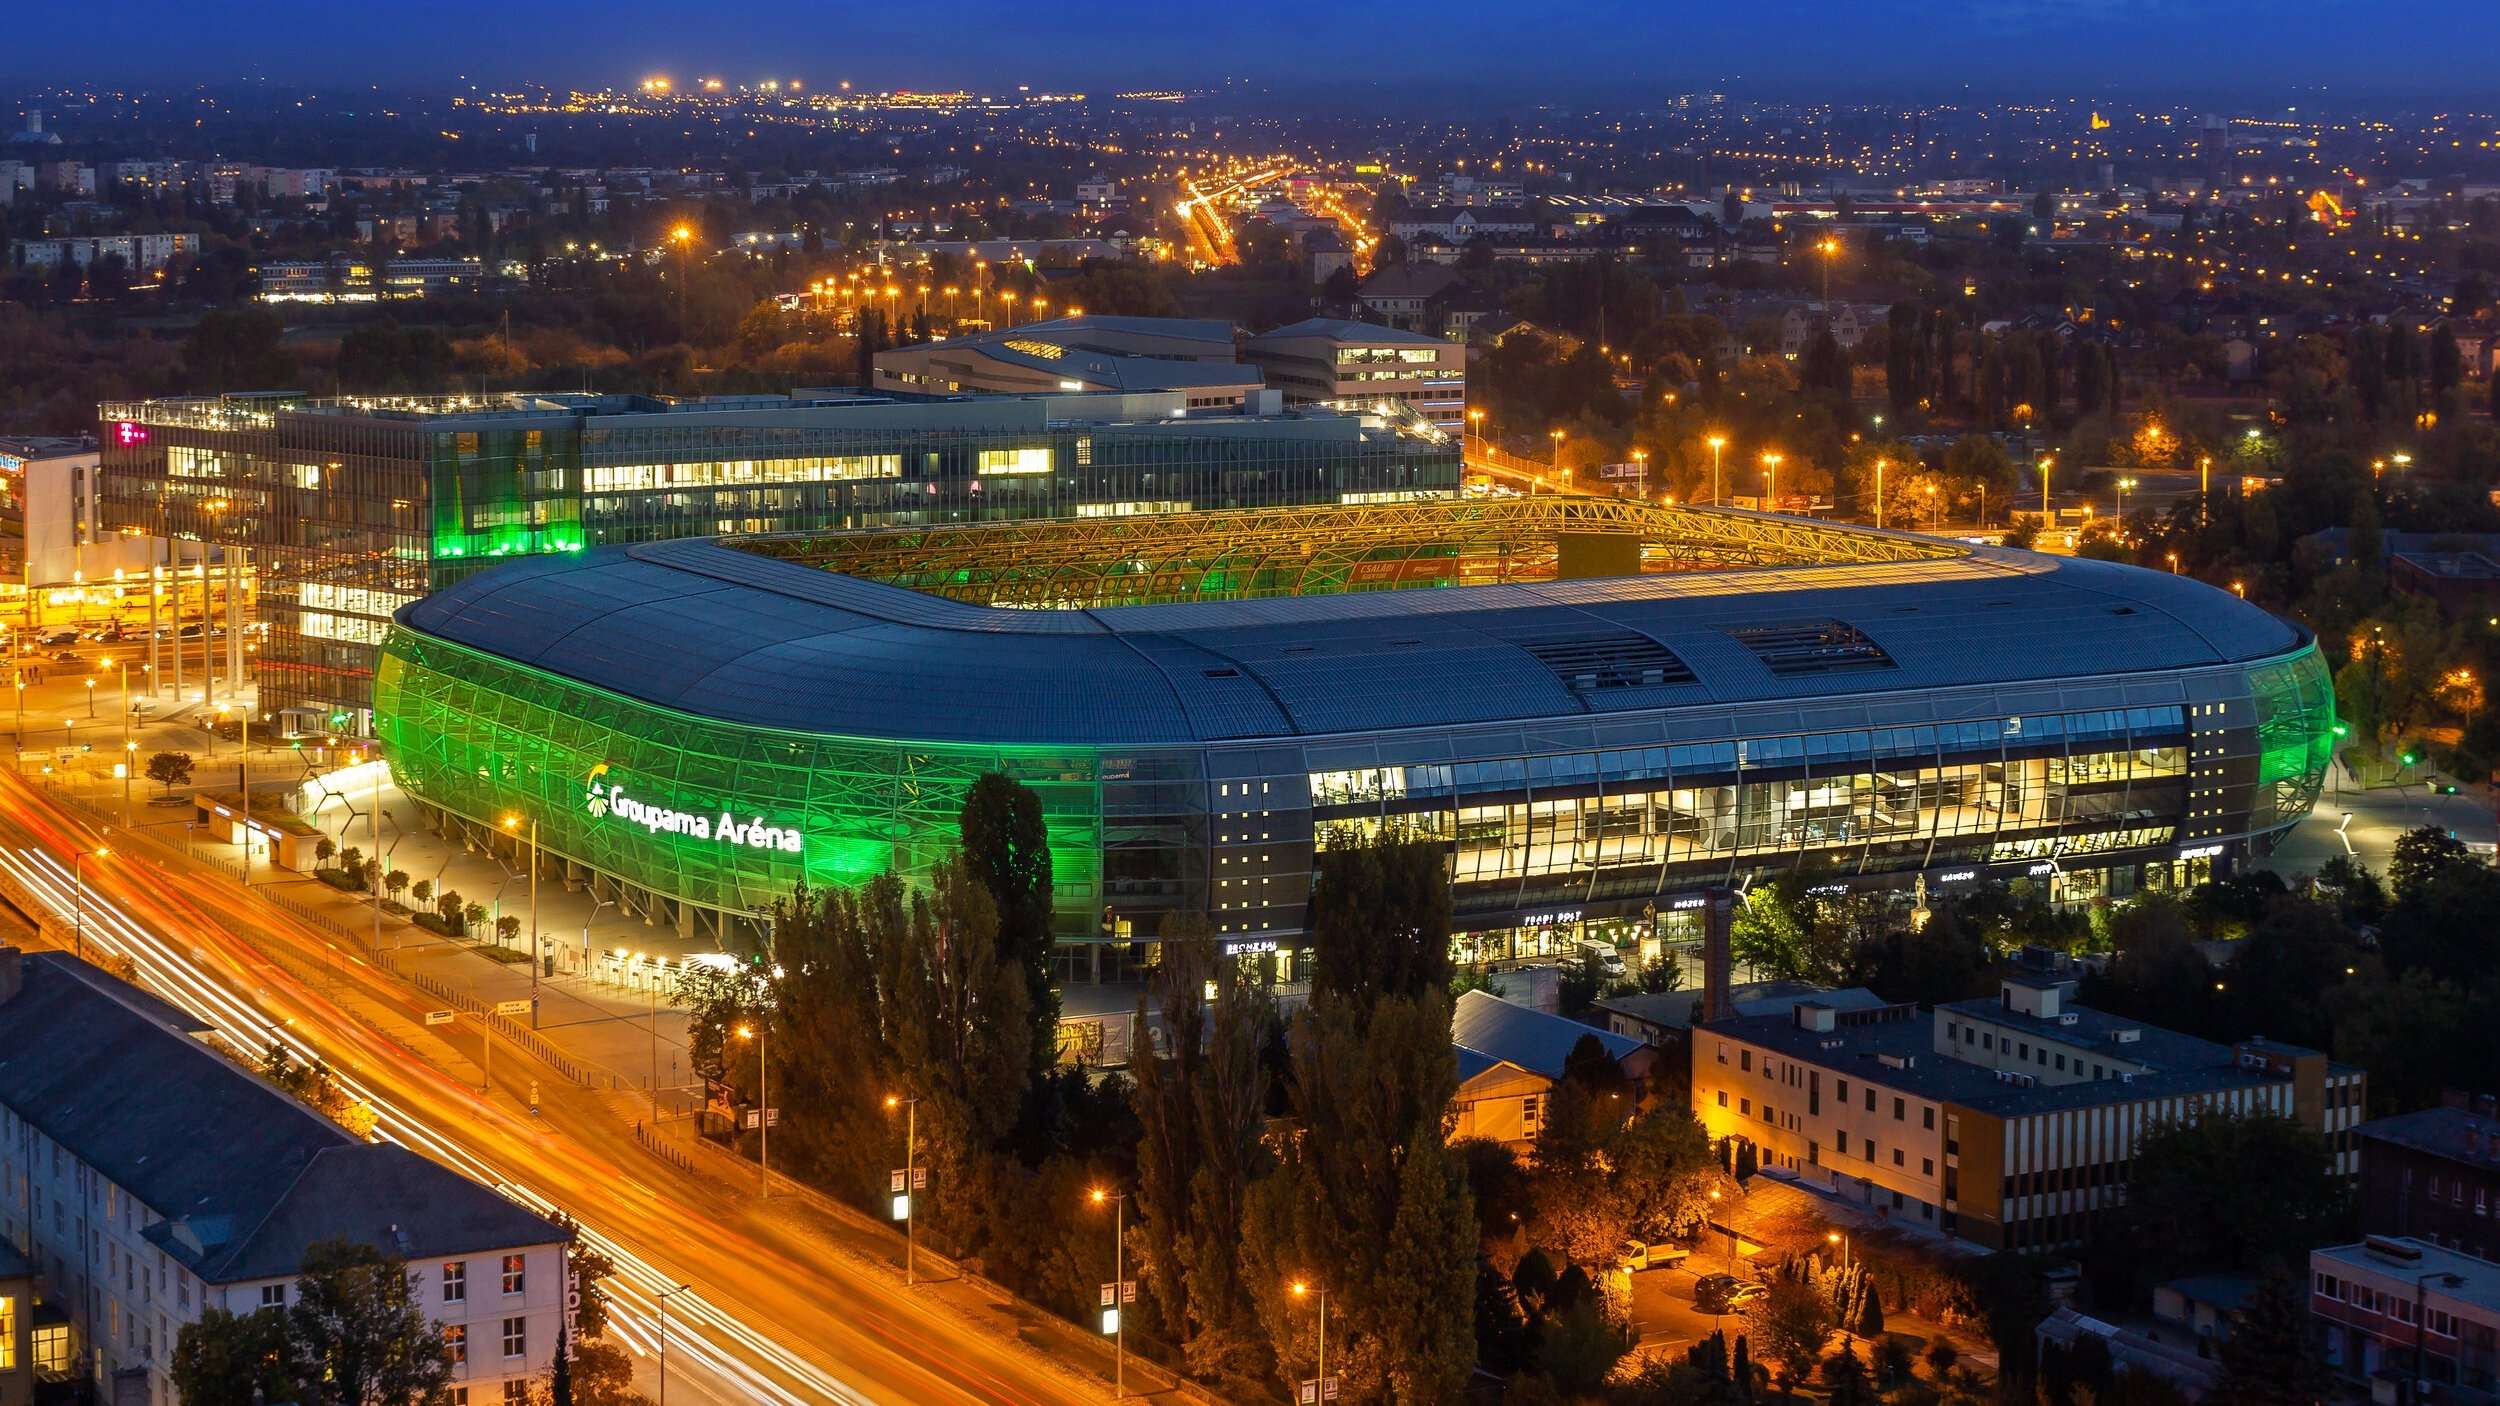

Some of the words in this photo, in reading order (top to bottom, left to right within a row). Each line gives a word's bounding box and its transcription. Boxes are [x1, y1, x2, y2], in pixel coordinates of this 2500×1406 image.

[610, 786, 710, 839] Groupama
[715, 813, 802, 852] Aréna
[1674, 899, 1706, 908] MÚZEU
